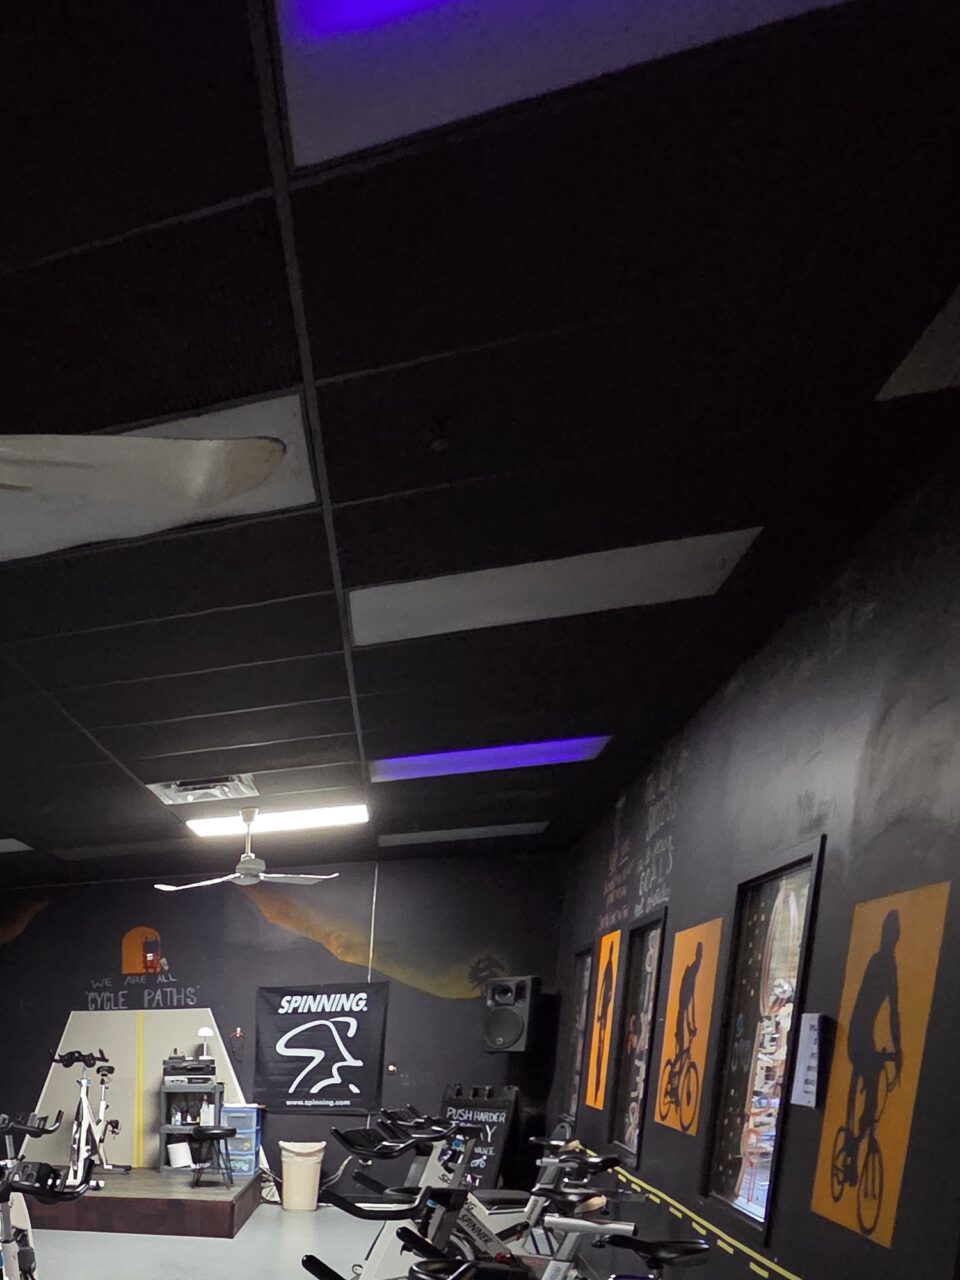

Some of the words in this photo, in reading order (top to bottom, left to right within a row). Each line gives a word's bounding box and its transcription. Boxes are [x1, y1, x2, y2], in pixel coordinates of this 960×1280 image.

[124, 975, 147, 986] ARE
[157, 973, 177, 983] ALL
[446, 1106, 472, 1120] PUSH
[474, 1110, 507, 1123] HARDER
[458, 1213, 494, 1244] SPINNER
